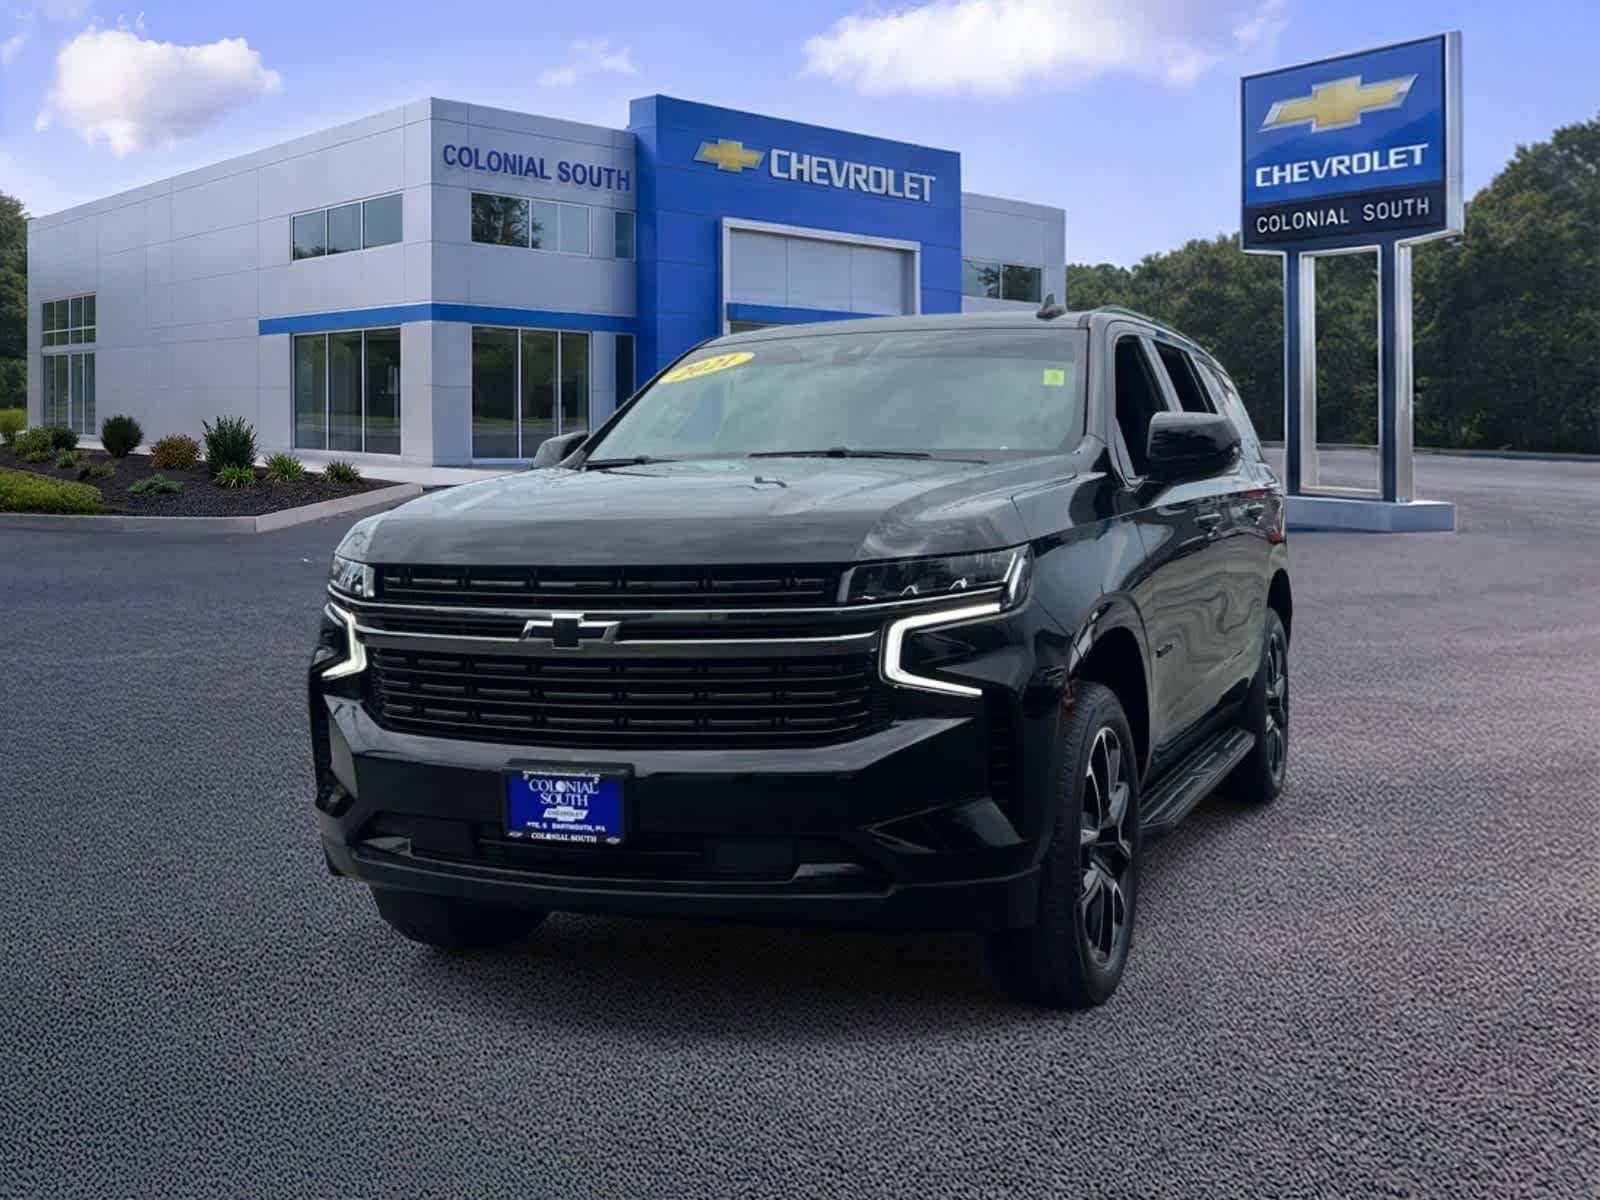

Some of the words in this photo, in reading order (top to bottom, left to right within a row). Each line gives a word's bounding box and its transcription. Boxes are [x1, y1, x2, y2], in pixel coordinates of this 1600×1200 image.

[443, 144, 552, 180] COLONIAL
[557, 161, 630, 191] SOUTH
[770, 148, 937, 202] CHEVROLET
[1255, 143, 1429, 187] CHEVROLET
[1256, 208, 1349, 233] COLONIAL
[1363, 197, 1430, 221] SOUTH
[528, 779, 599, 794] COLONIAL
[540, 792, 588, 807] SOUTH
[531, 832, 570, 841] COLONIAL
[570, 834, 597, 844] SOUTH
